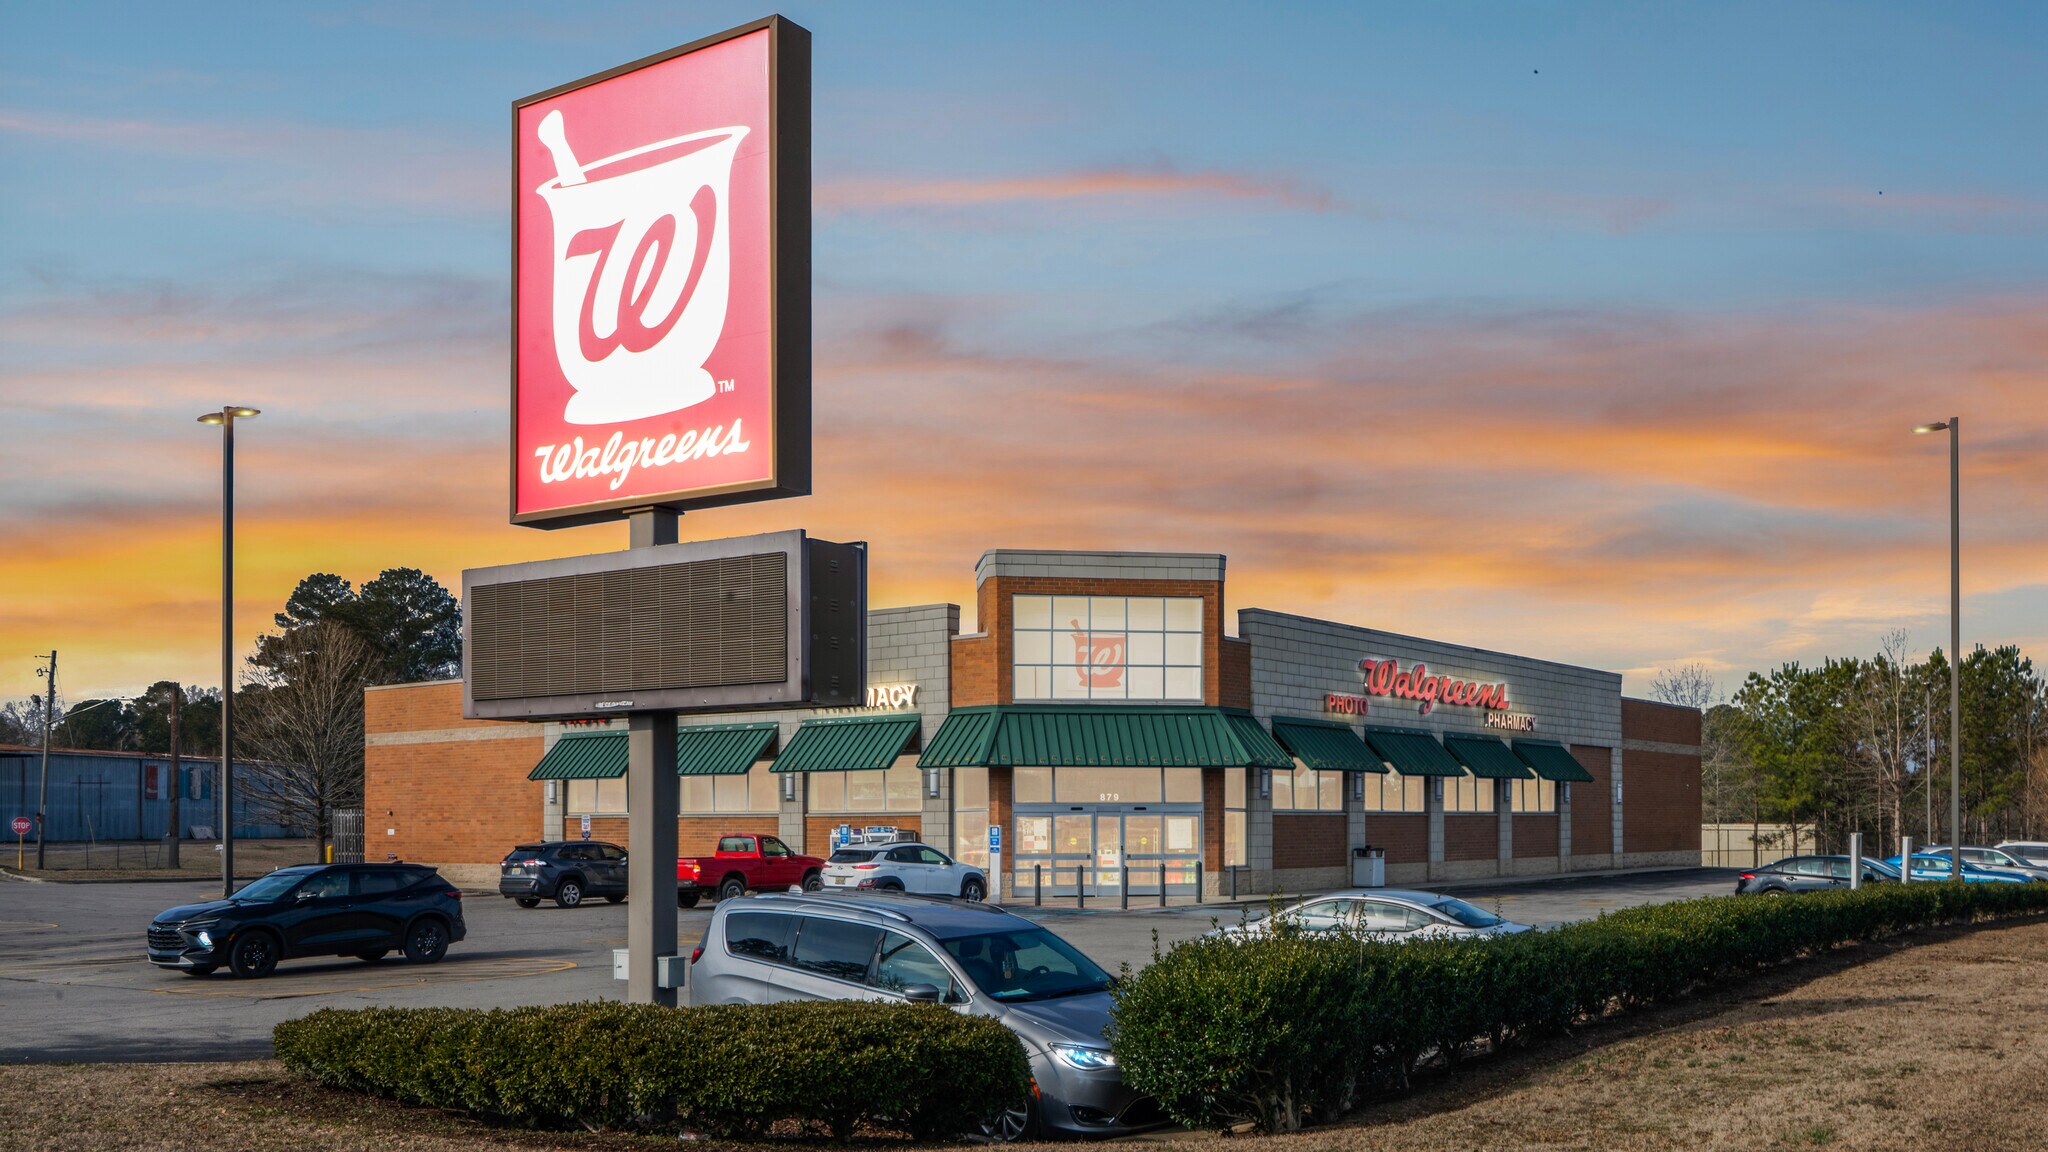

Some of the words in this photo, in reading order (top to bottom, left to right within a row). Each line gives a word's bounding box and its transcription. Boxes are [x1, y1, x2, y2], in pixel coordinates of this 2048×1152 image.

[565, 184, 717, 363] W
[718, 379, 735, 393] TM
[535, 418, 750, 491] Walgreens
[1077, 643, 1122, 676] W
[1361, 659, 1510, 714] Walgreens
[1328, 693, 1369, 716] PHOTO
[1488, 712, 1537, 731] PHARMACY
[1100, 793, 1119, 801] 879
